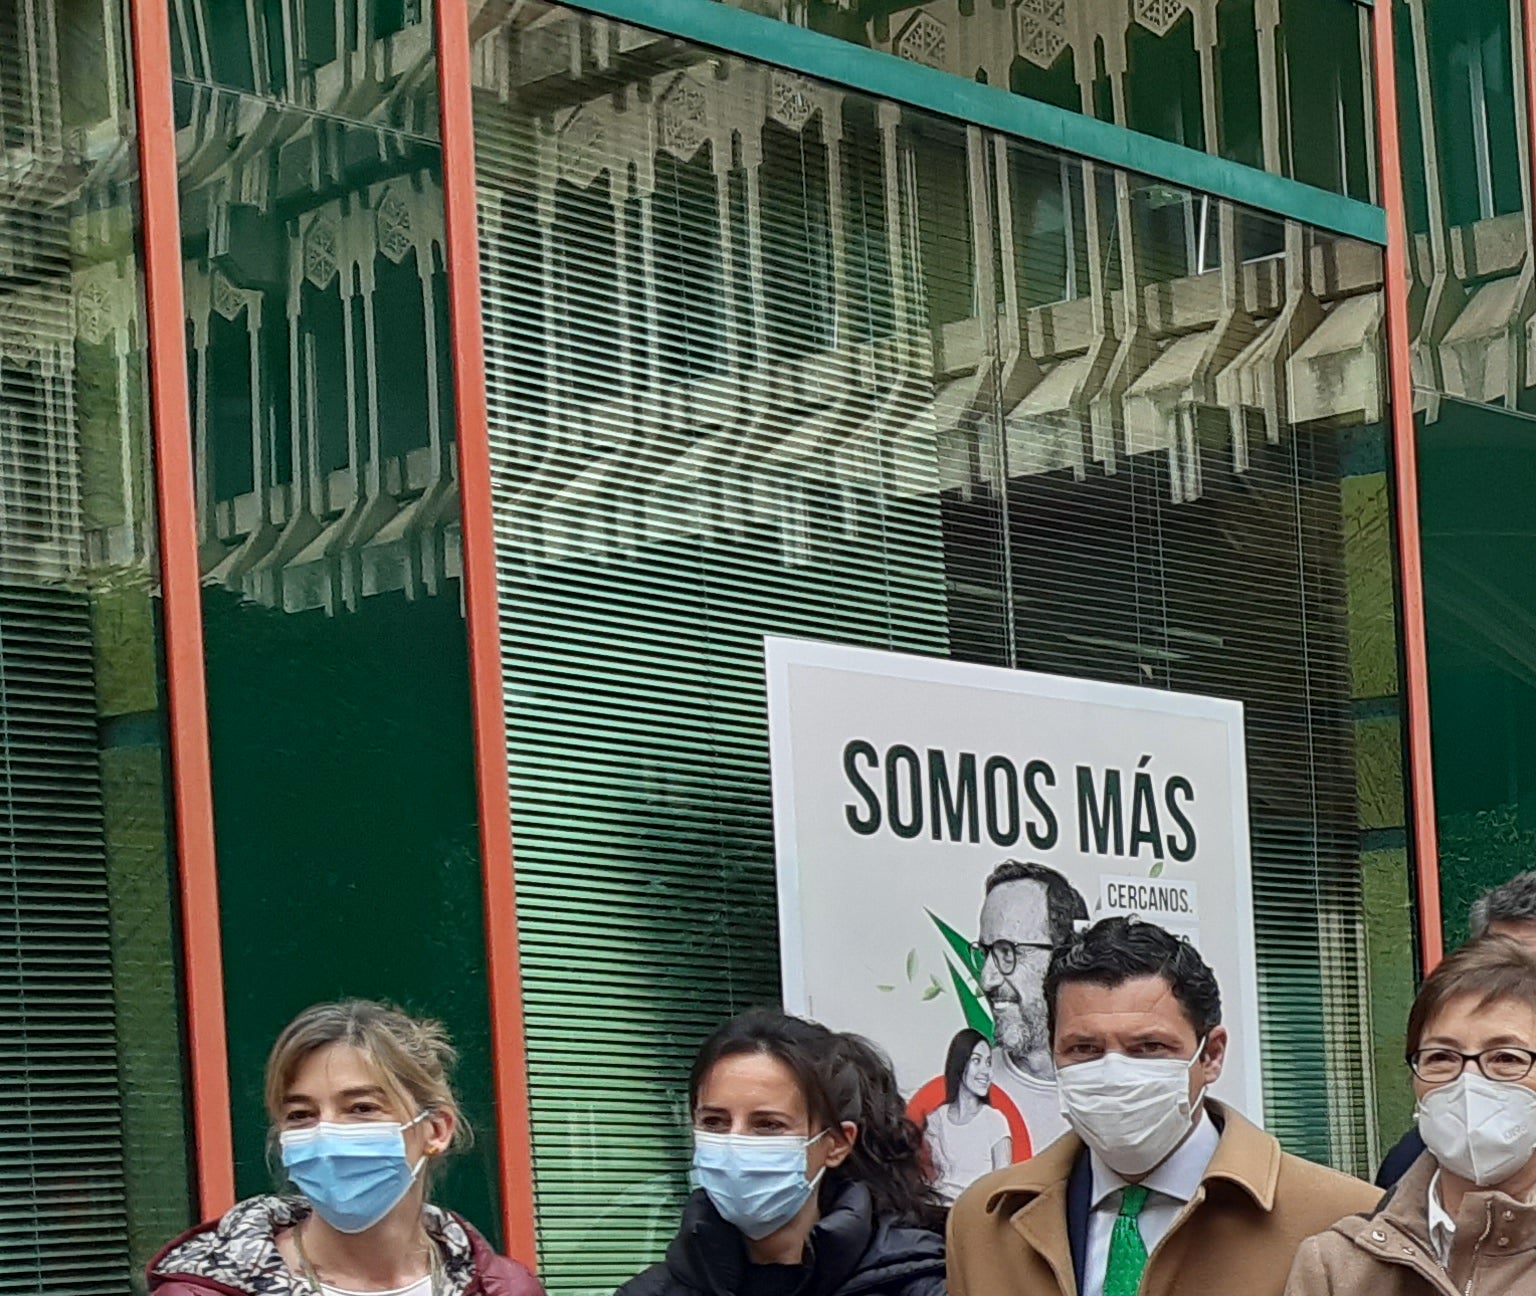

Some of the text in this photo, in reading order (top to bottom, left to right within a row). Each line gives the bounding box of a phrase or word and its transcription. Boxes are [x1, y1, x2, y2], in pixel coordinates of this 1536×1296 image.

[842, 738, 1198, 864] SOMOS MÁS
[1107, 882, 1194, 914] CERCANOS.
